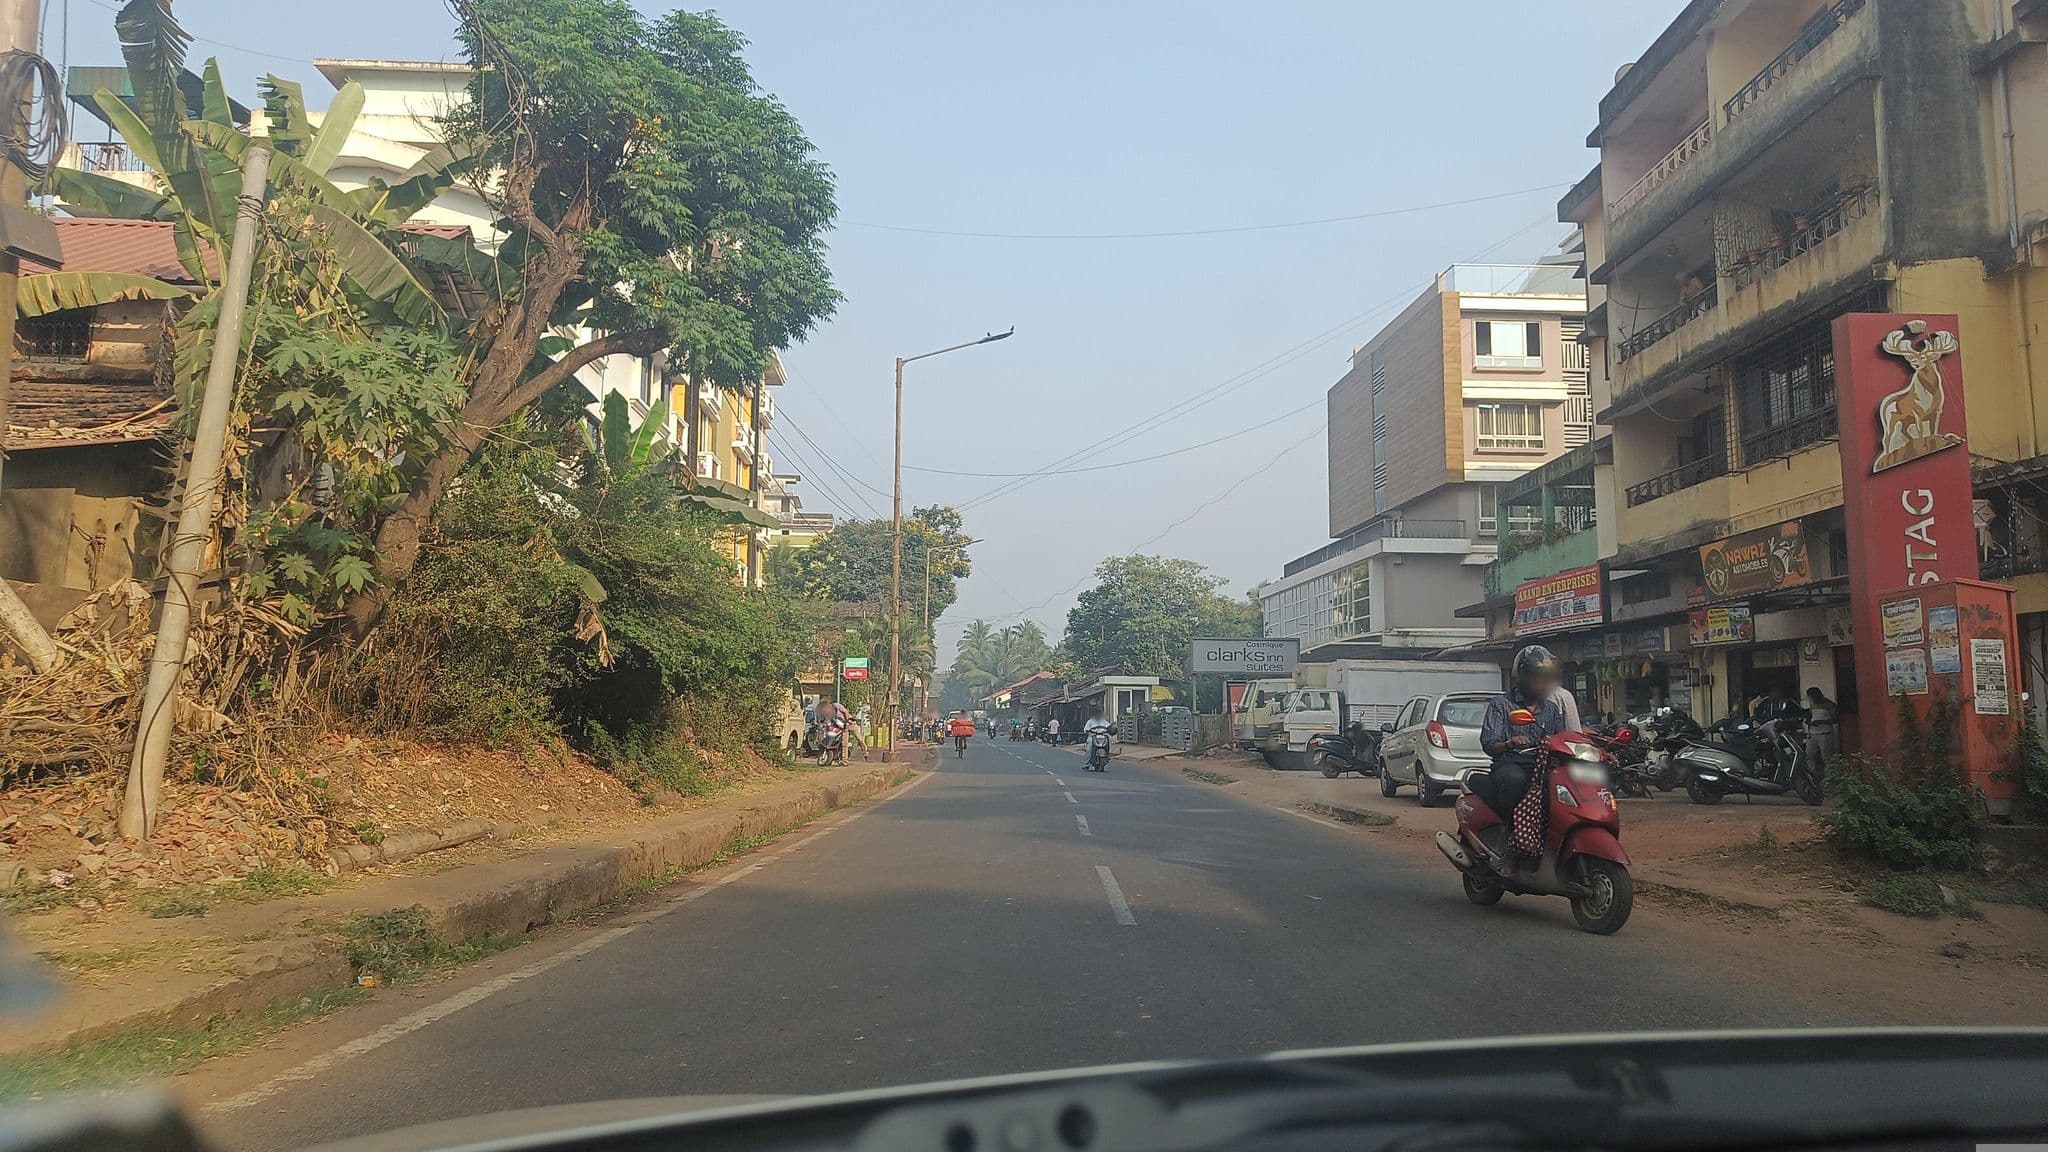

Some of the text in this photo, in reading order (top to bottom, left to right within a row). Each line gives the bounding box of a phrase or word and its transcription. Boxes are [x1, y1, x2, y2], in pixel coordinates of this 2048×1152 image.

[1726, 542, 1767, 566] NAWAZ
[1732, 558, 1769, 575] AUTOMOBILES
[1519, 585, 1541, 602] ANAND
[1542, 572, 1597, 596] ENTERPRISES
[1246, 641, 1284, 649] Cosmique
[1207, 647, 1284, 662] clarks inn
[1246, 663, 1284, 672] suites
